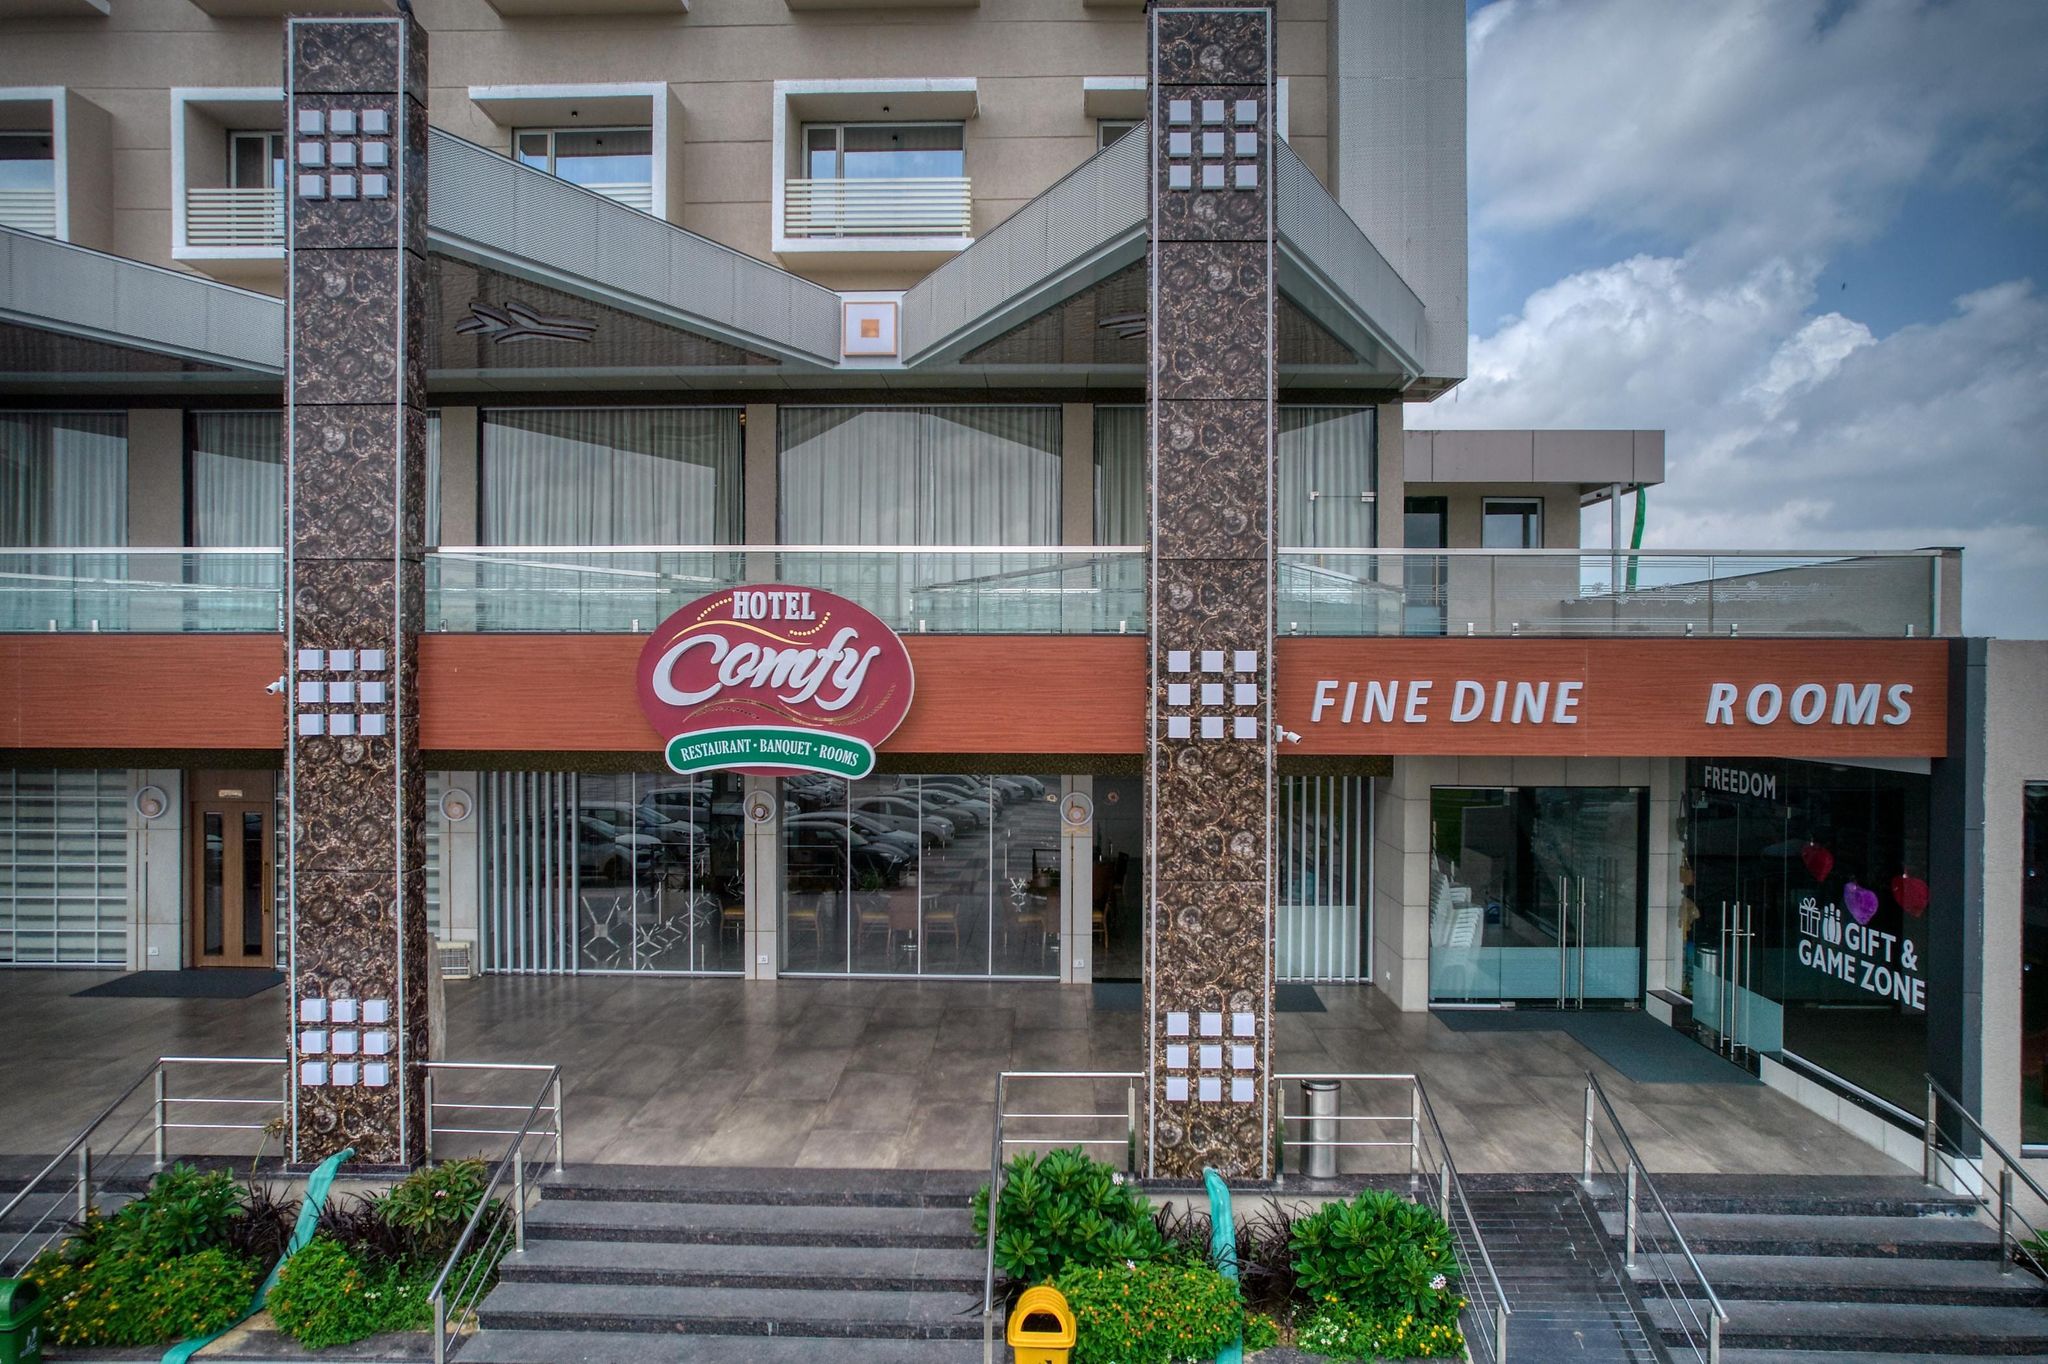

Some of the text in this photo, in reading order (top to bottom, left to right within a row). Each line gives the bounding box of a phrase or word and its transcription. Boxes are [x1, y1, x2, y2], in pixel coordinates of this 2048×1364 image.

[732, 591, 816, 621] HOTEL
[652, 627, 881, 711] Comfy
[1311, 680, 1584, 724] FINE DINE
[1705, 682, 1914, 726] ROOMS
[680, 738, 859, 767] RESTAURANT BANQUET ROOMS
[1704, 765, 1776, 800] FREEDOM
[1845, 922, 1918, 971] GIFT &
[1798, 939, 1926, 1011] GAME ZONE
